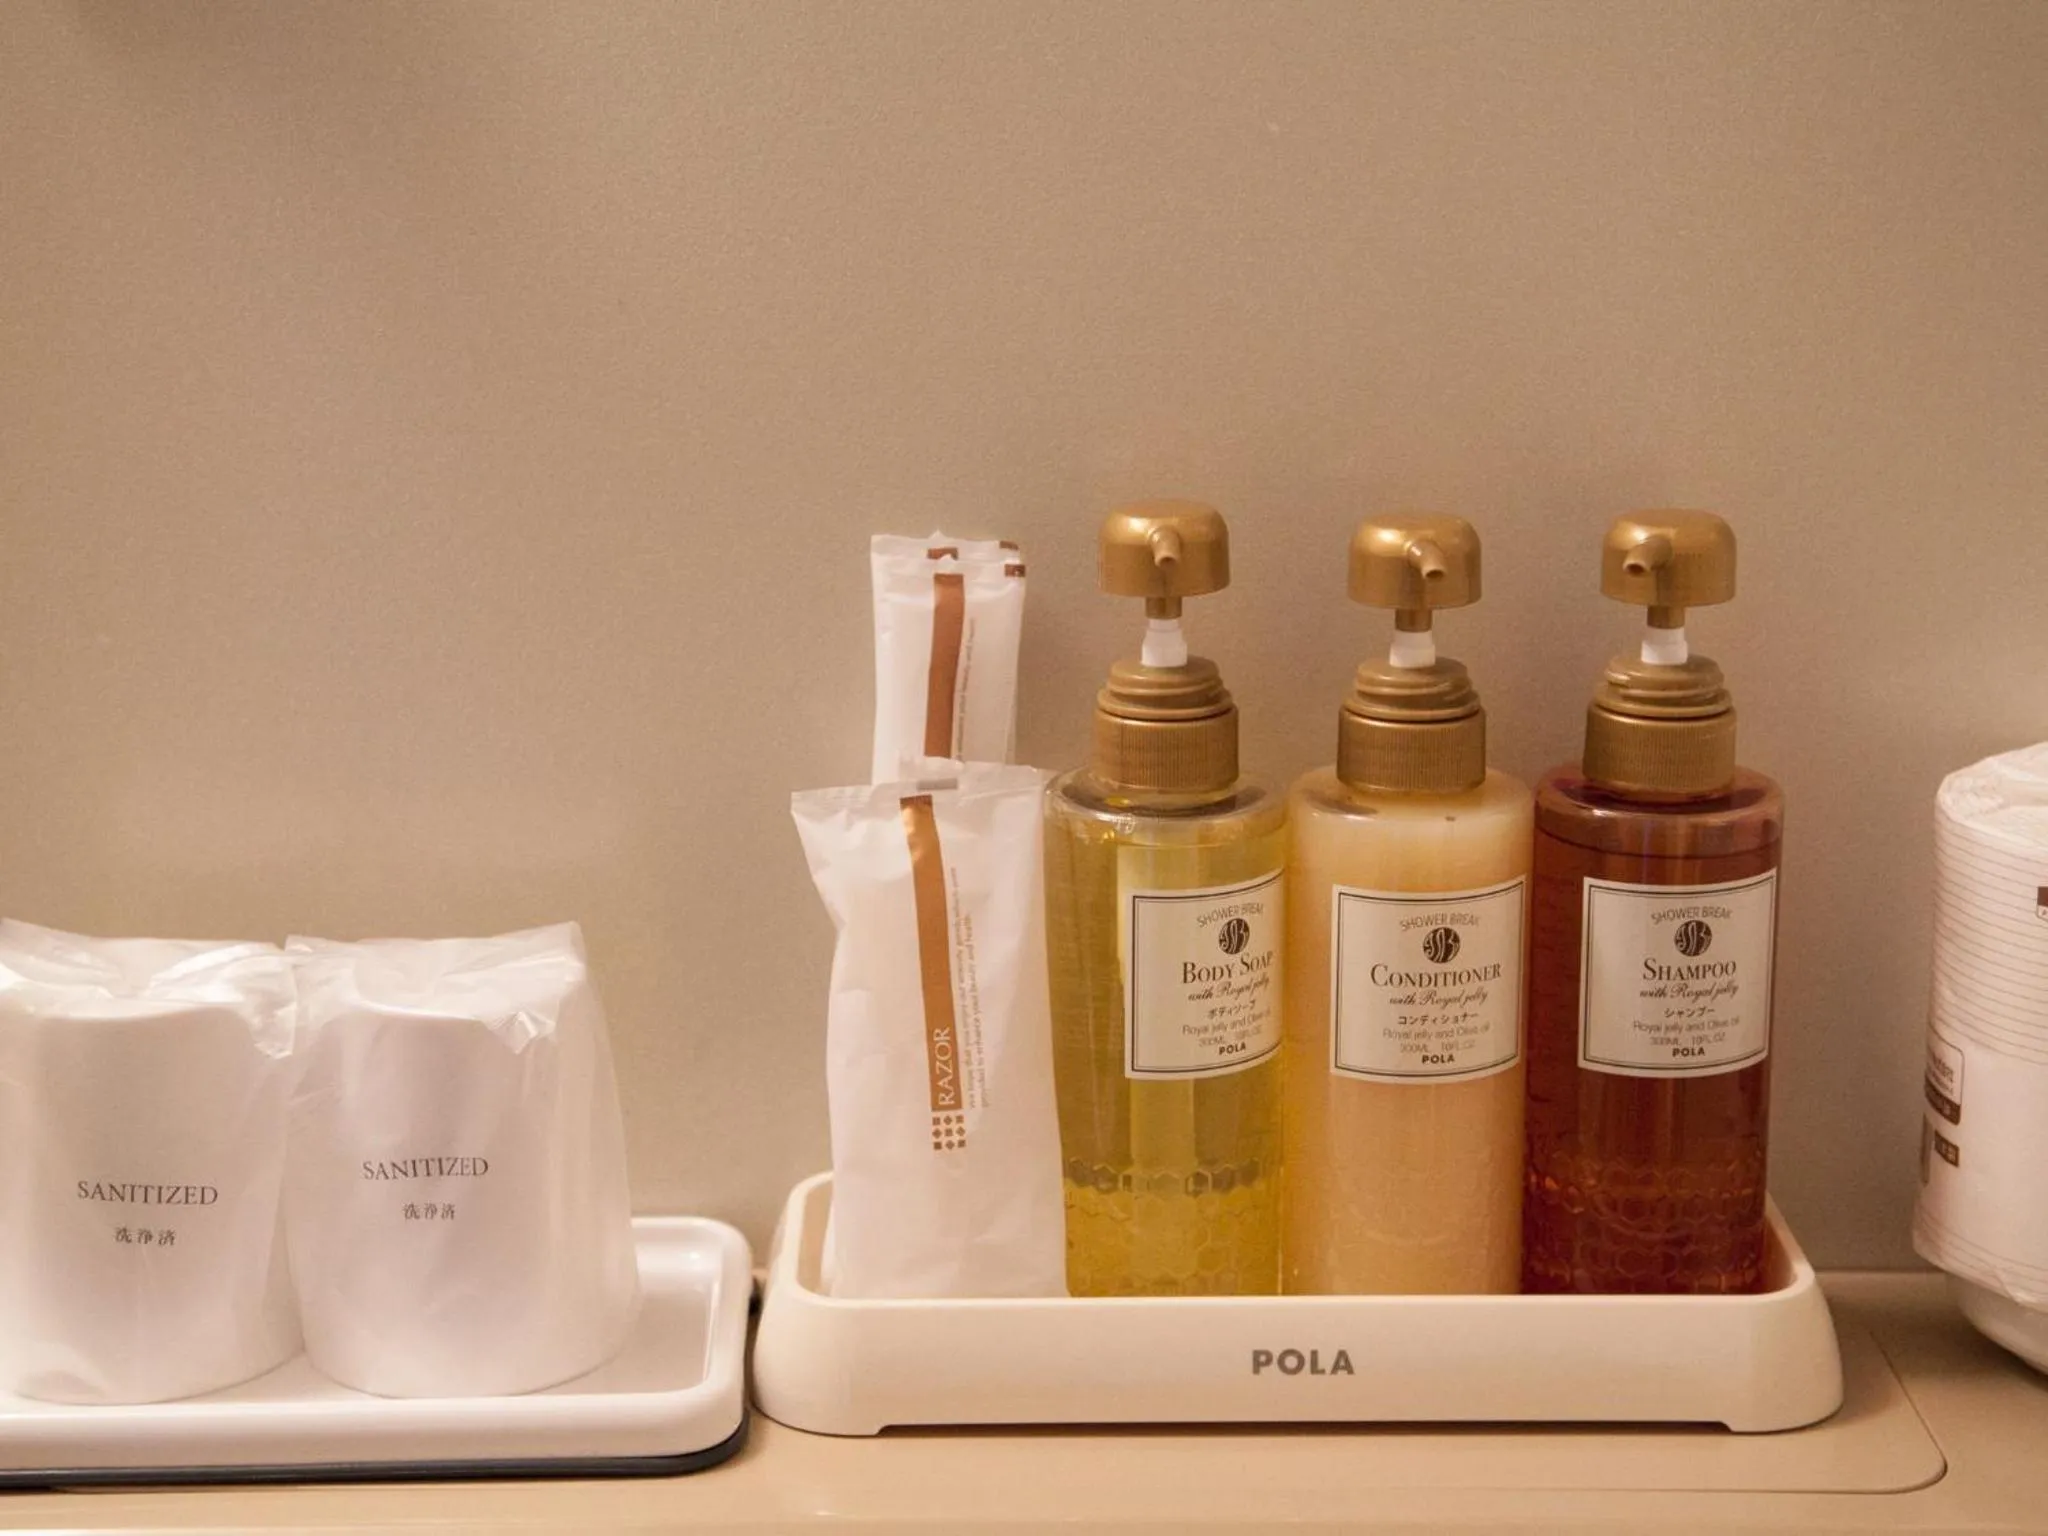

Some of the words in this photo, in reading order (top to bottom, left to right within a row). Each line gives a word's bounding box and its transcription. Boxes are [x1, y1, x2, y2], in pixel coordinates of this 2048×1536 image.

[1399, 913, 1448, 932] SHOWER
[1650, 906, 1700, 926] SHOWER
[1389, 991, 1417, 1006] with
[1639, 984, 1667, 999] with
[1397, 1012, 1480, 1026] コンディショナー
[1663, 1005, 1716, 1019] シャンプー
[1218, 1041, 1247, 1056] POLA
[1671, 1046, 1706, 1058] POLA
[933, 1027, 955, 1106] RAZOR
[1421, 1053, 1456, 1065] POLA
[362, 1156, 489, 1181] SANITIZED
[77, 1180, 219, 1207] SANITIZED
[1251, 1348, 1357, 1376] POLA
